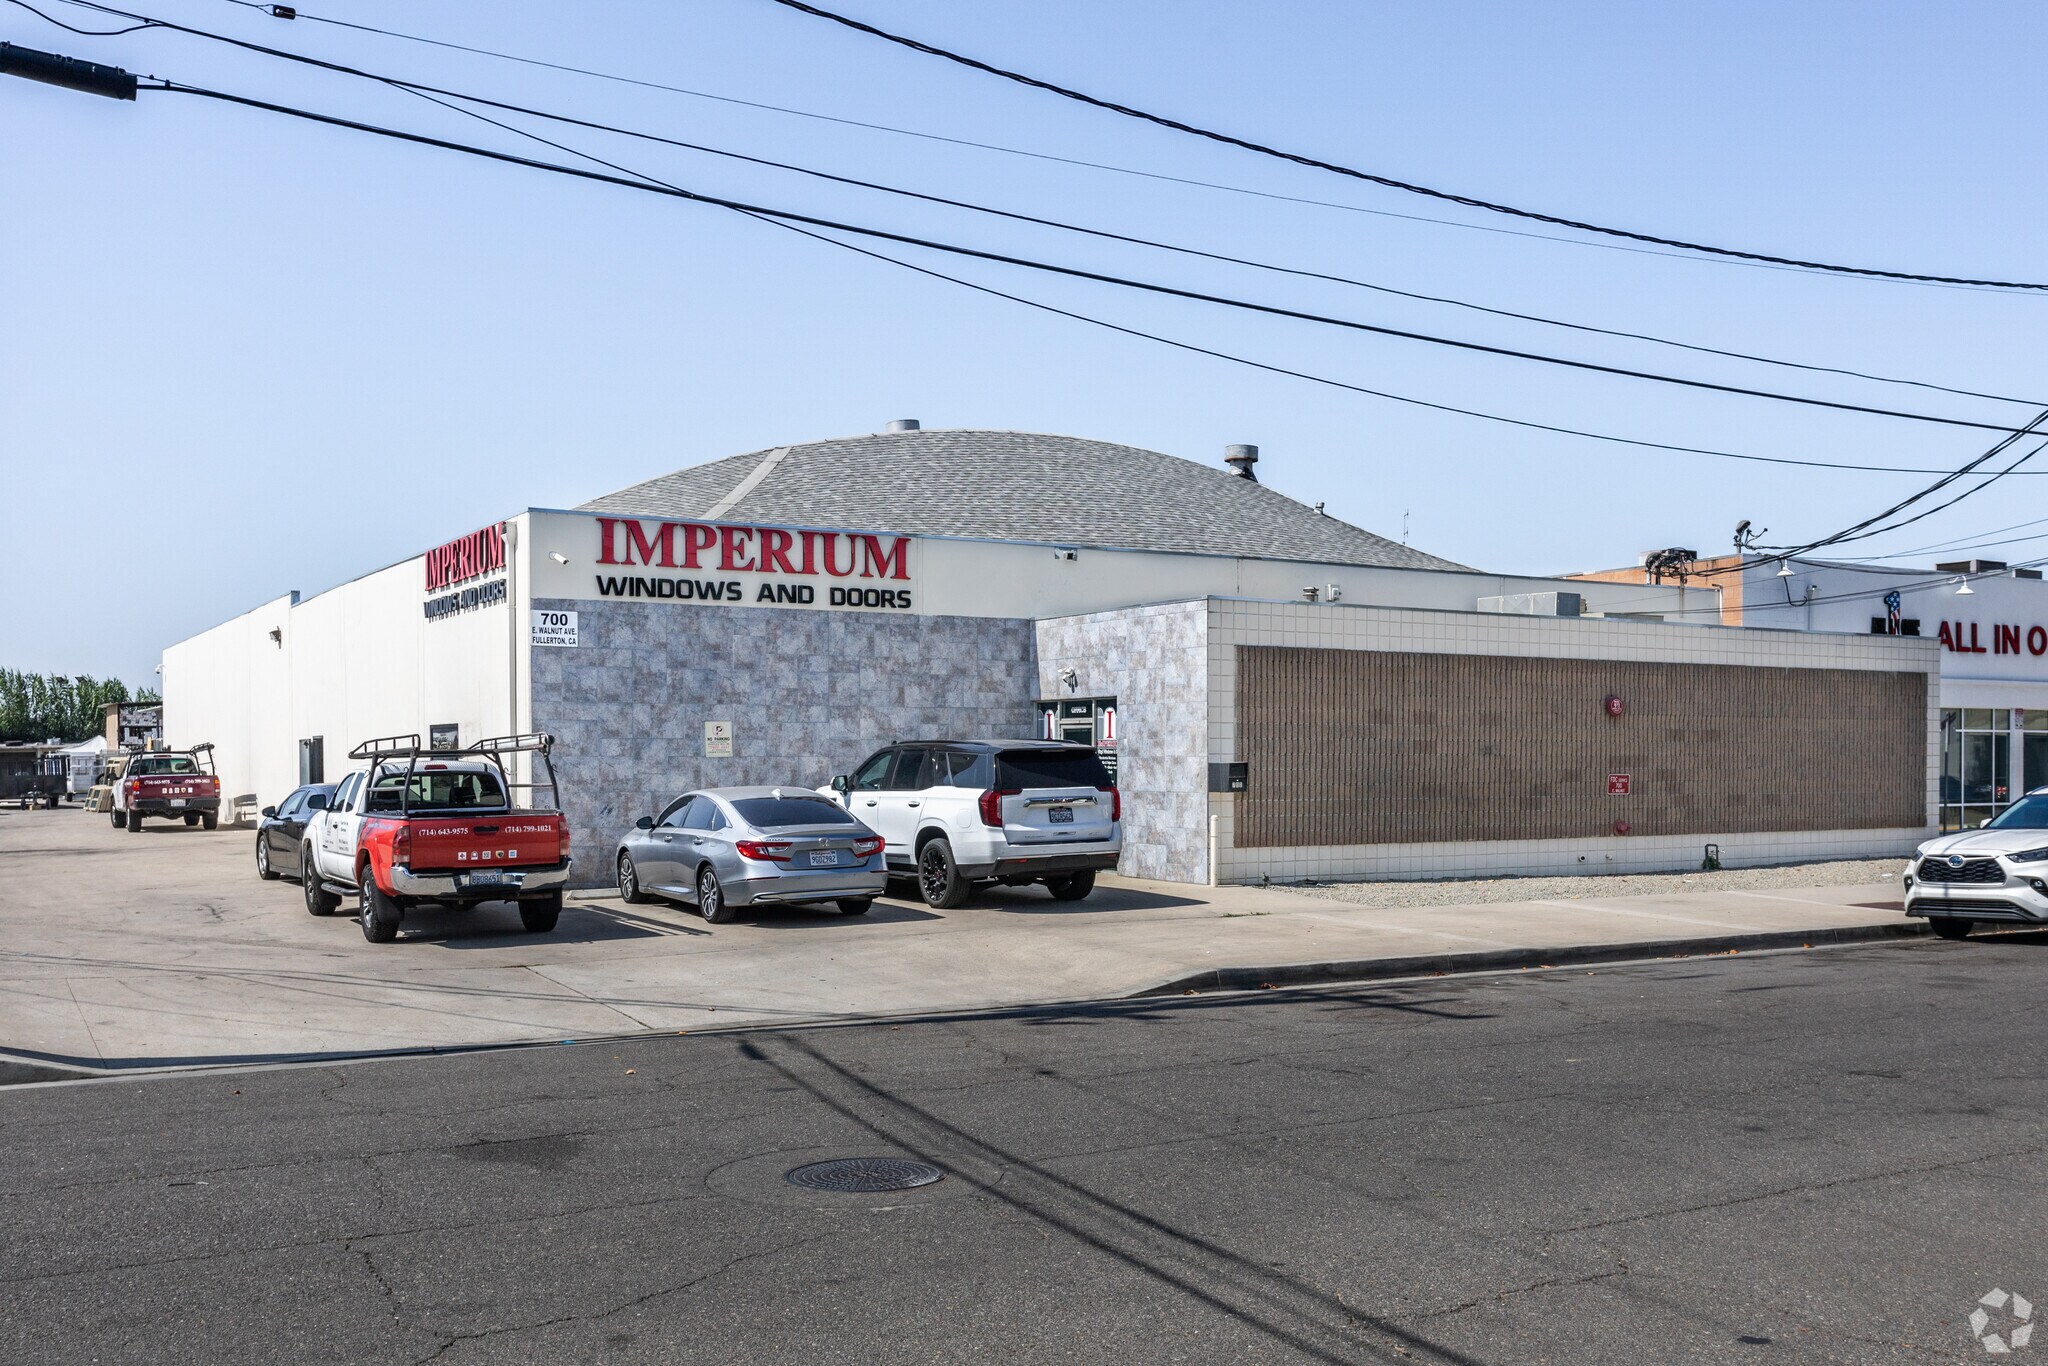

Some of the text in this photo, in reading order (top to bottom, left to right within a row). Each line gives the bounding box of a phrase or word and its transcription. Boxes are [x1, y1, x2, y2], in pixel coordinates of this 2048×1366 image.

[424, 521, 507, 591] IMPERIUM
[595, 518, 912, 580] IMPERIUM
[423, 579, 507, 619] WINDOWS AND DOORS
[595, 575, 912, 609] WINDOWS AND DOORS
[531, 626, 578, 636] E. WALNUT AVE.
[540, 612, 569, 626] 700
[532, 636, 577, 646] FULLERTON, CA
[1938, 620, 1987, 653] ALL
[1994, 624, 2021, 655] IN
[437, 827, 469, 836] 643-9575
